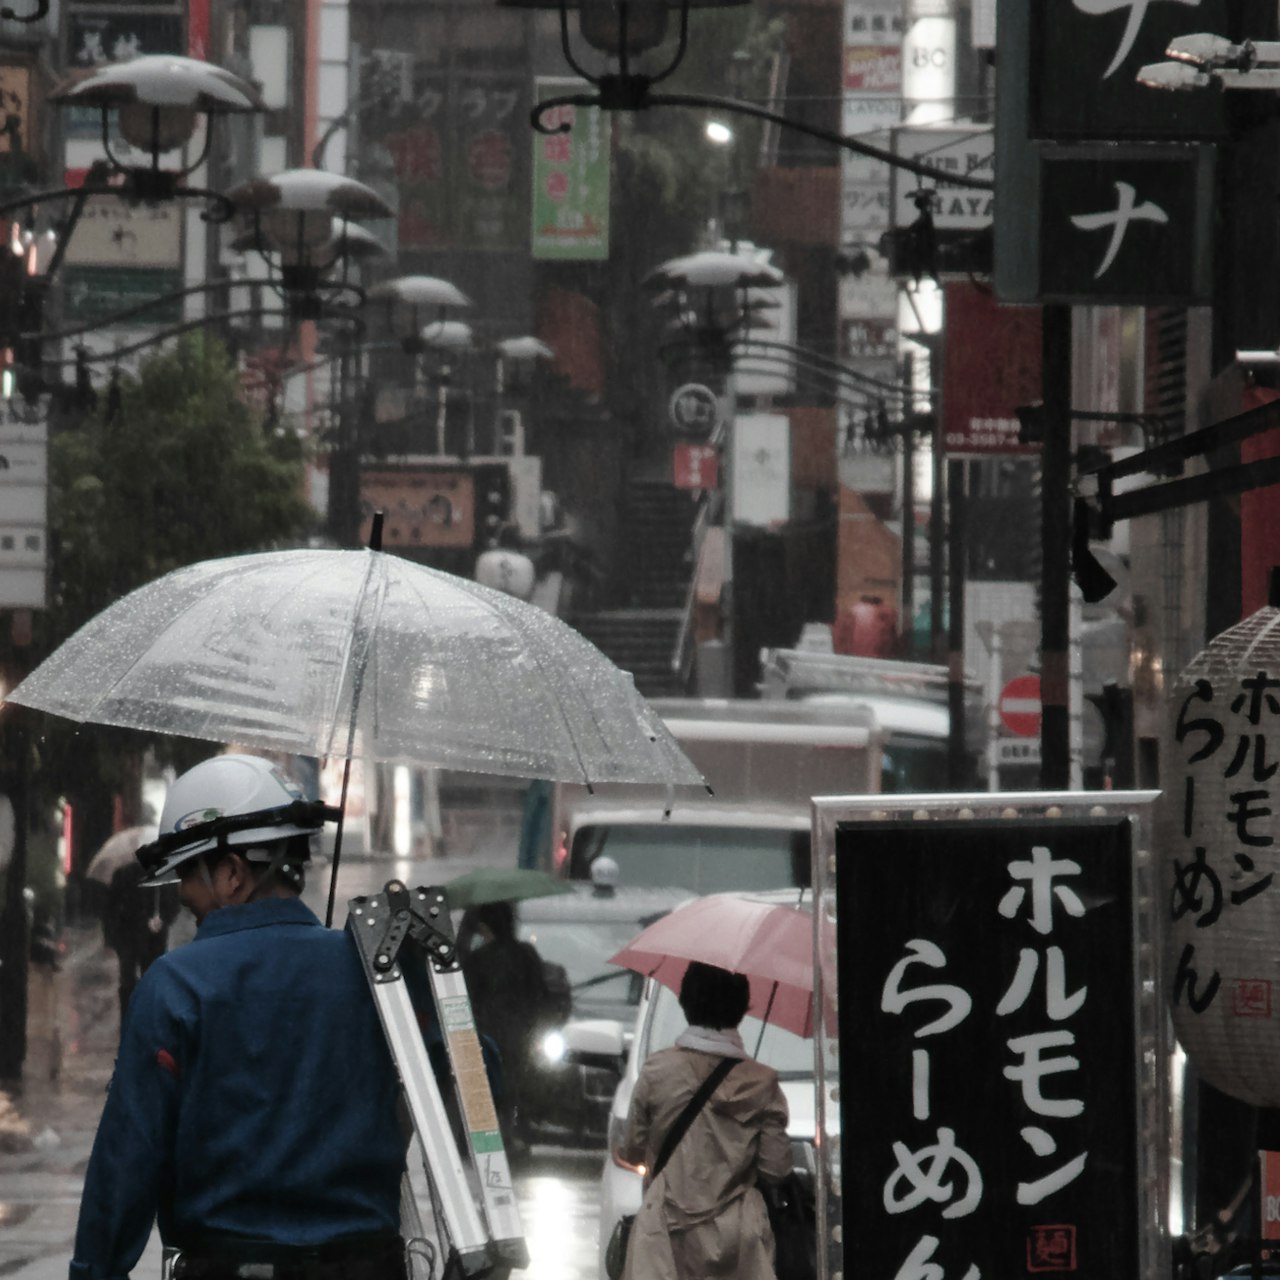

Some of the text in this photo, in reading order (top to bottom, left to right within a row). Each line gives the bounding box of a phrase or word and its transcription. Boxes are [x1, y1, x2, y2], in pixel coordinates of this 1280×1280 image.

[1070, 181, 1168, 279] ナ
[1171, 679, 1225, 1015] らーめん
[997, 846, 1089, 1205] ホルモン
